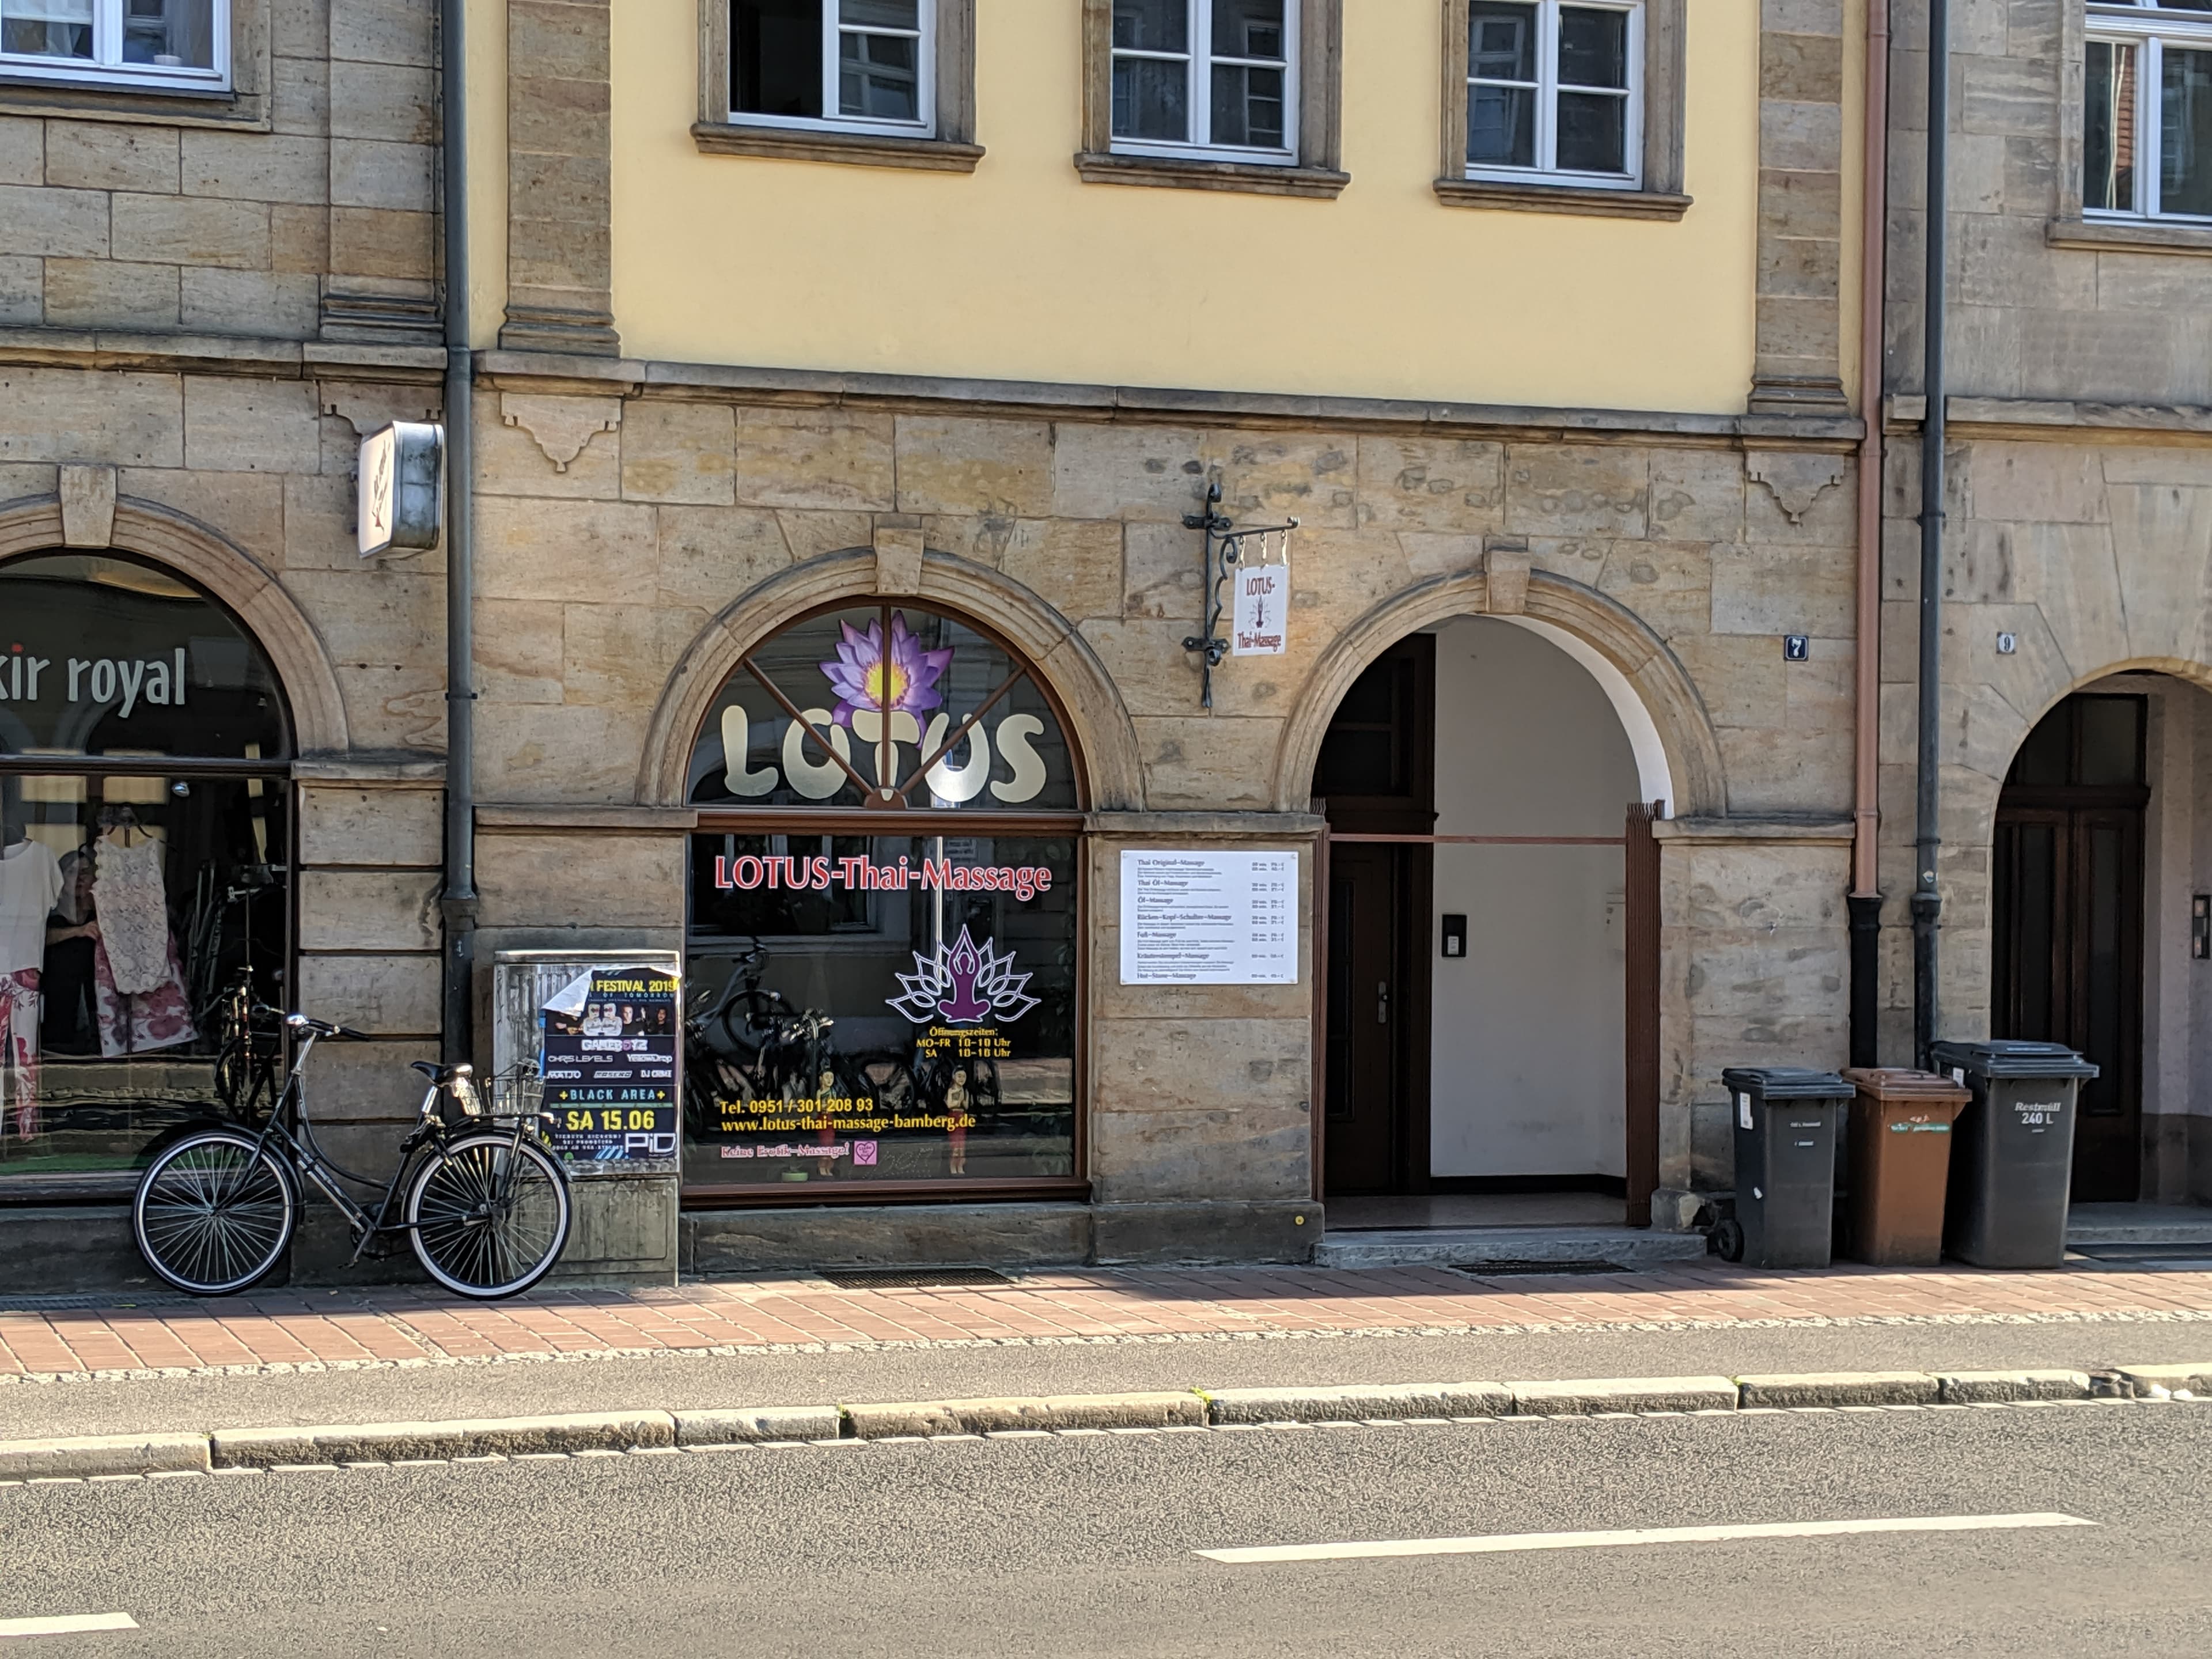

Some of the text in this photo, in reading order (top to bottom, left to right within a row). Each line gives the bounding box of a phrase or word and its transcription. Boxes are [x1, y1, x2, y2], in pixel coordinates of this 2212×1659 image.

[1237, 631, 1281, 652] Thai-Massage
[1791, 638, 1802, 657] 7
[67, 648, 185, 718] royal
[721, 705, 1047, 803] LOTUS
[715, 854, 1052, 902] LOTUS-Thai-Massage
[596, 979, 676, 993] FESTIVAL 2019
[994, 1037, 1012, 1047] Uhr
[925, 1049, 938, 1058] SA
[994, 1048, 1012, 1058] Uhr
[570, 1089, 656, 1100] BLACK AREA
[720, 1100, 745, 1114] Tel.
[749, 1099, 783, 1113] 0951
[797, 1099, 821, 1113] 301
[826, 1098, 853, 1112] 208
[856, 1098, 873, 1112] 93
[566, 1110, 655, 1131] SA 15.06
[721, 1113, 976, 1132] www.lotus-thai-massage-bamberg.de
[2021, 1112, 2054, 1124] 240 L
[721, 1145, 754, 1158] Keine
